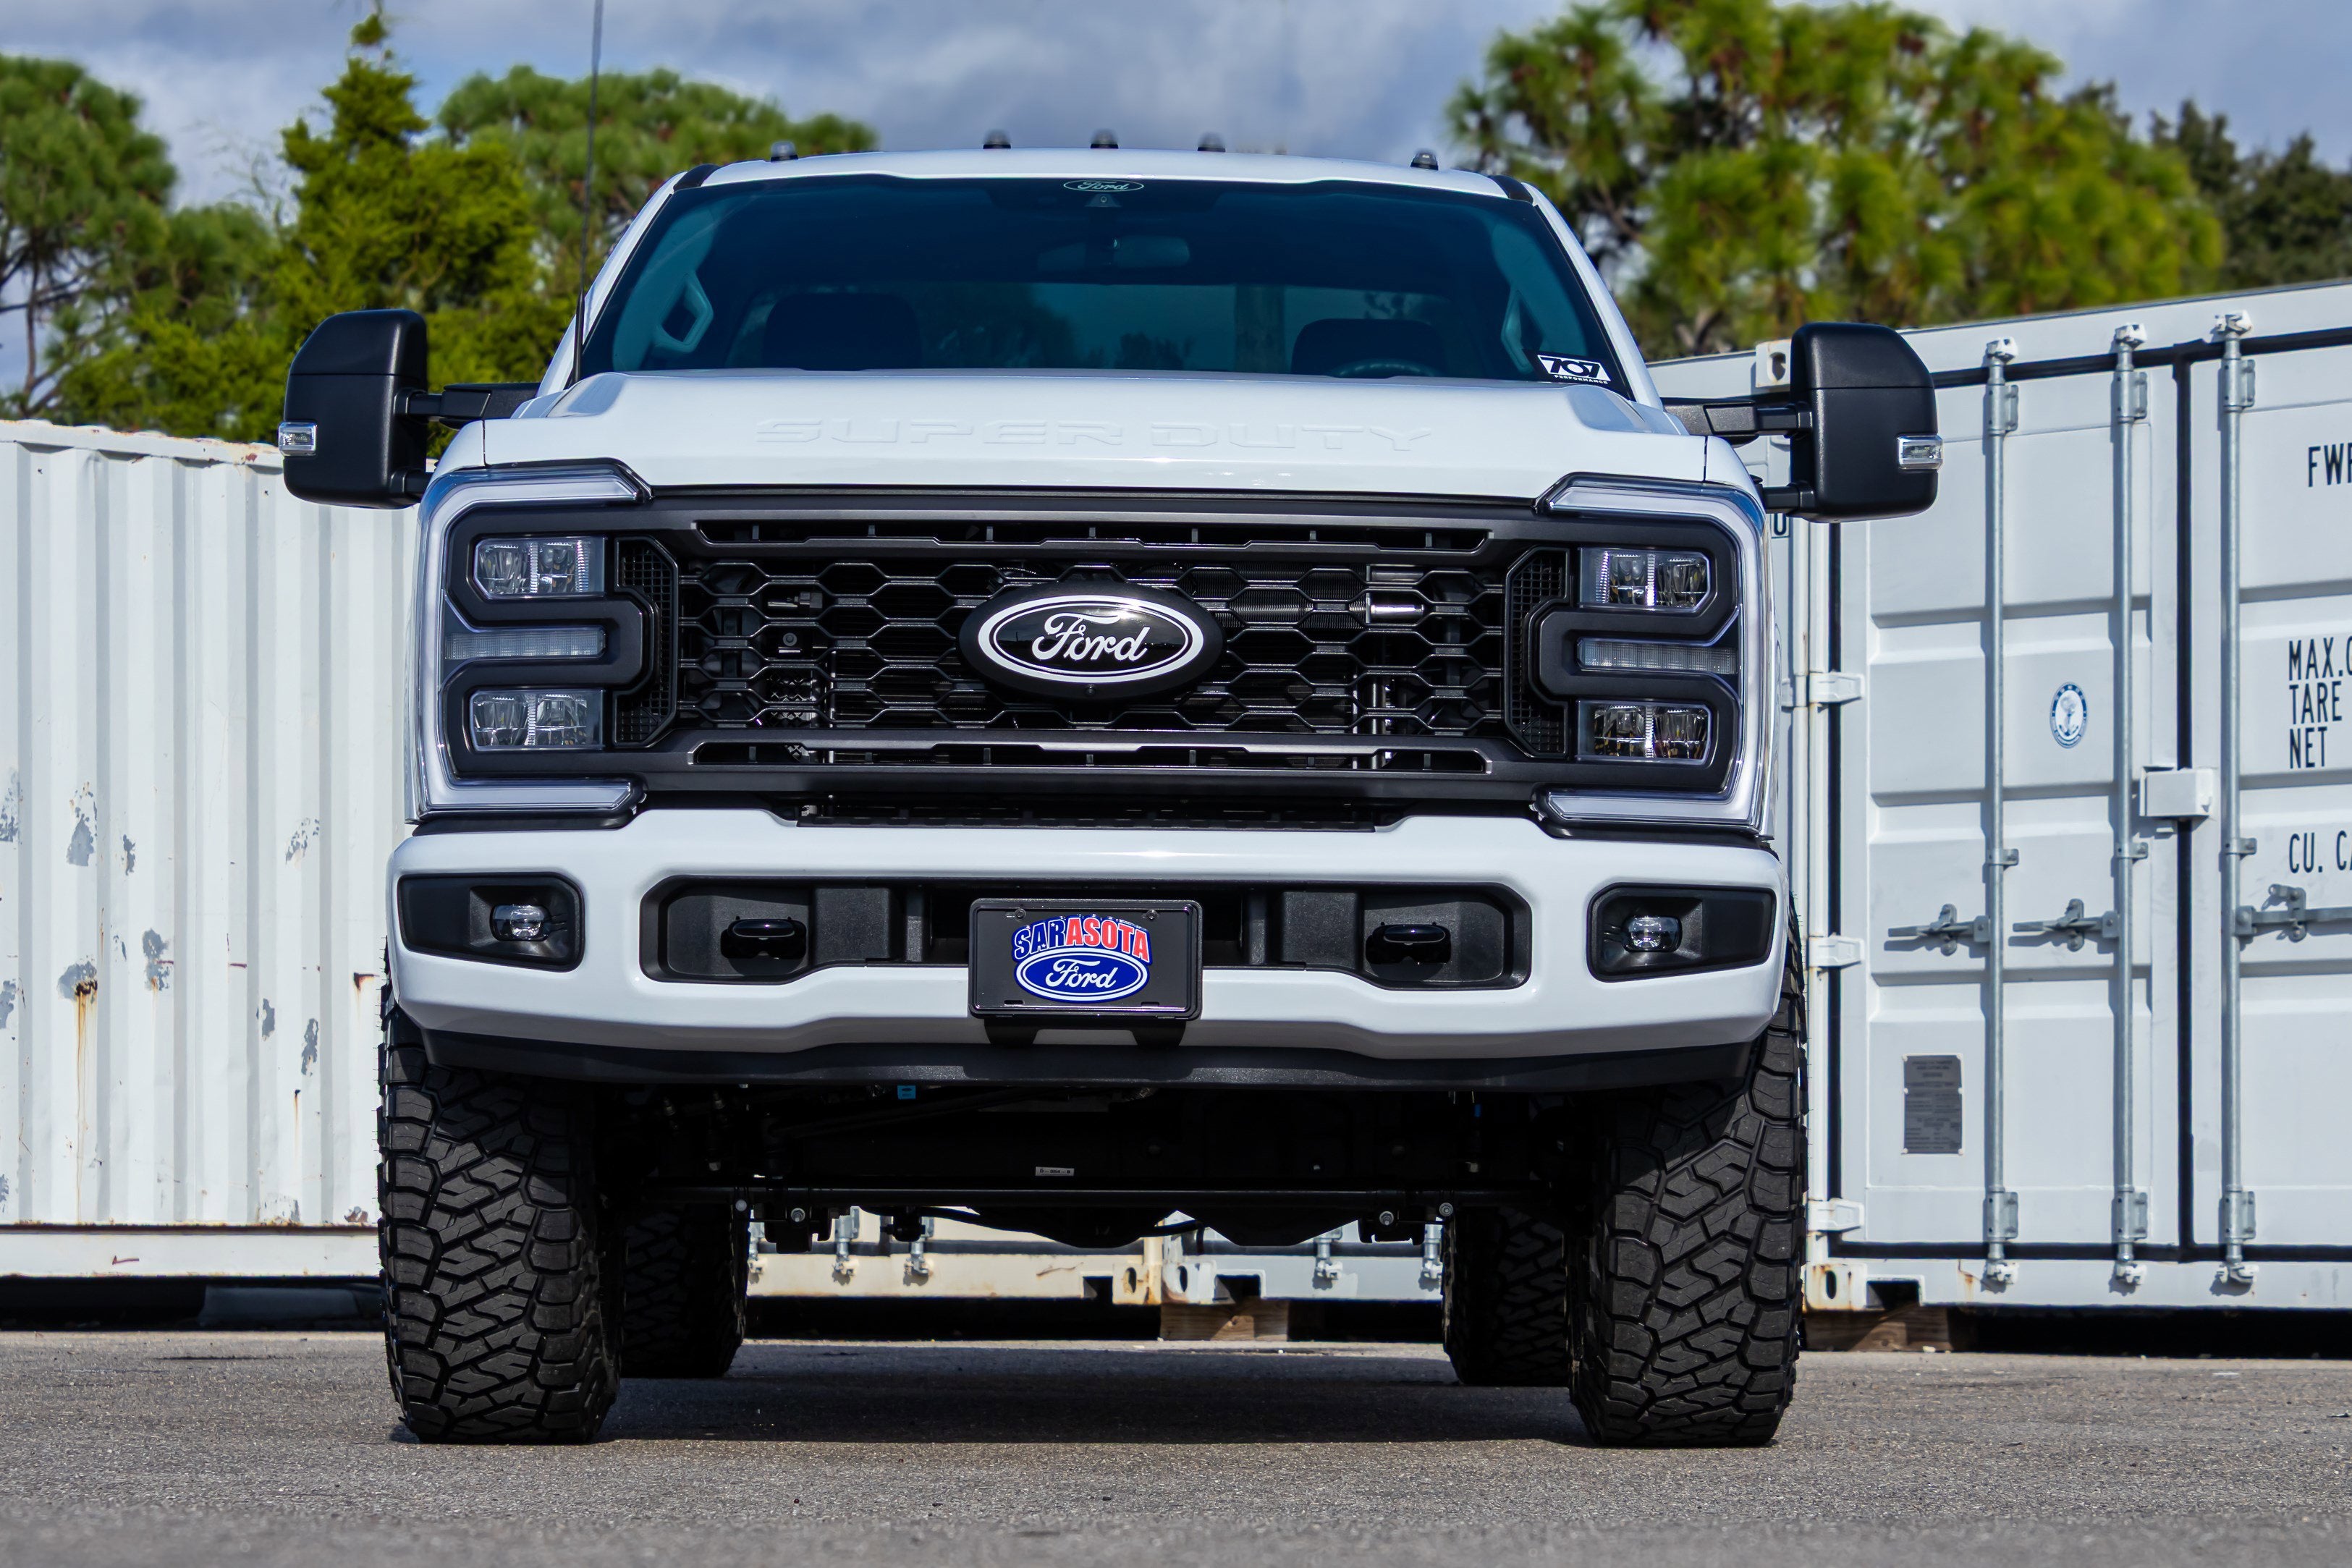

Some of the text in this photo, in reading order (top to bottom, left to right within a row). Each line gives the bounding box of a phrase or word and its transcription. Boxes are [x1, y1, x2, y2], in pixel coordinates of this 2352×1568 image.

[1078, 181, 1128, 190] Ford
[1554, 374, 1609, 384] PERFORMANCE
[755, 418, 1431, 451] SUPER DUTY
[1032, 612, 1151, 661] Ford
[2289, 681, 2343, 724] TARE
[2290, 726, 2327, 769] NET
[2289, 830, 2352, 874] CU. C
[1014, 918, 1151, 963] SARASOTA
[1045, 958, 1118, 988] Ford
